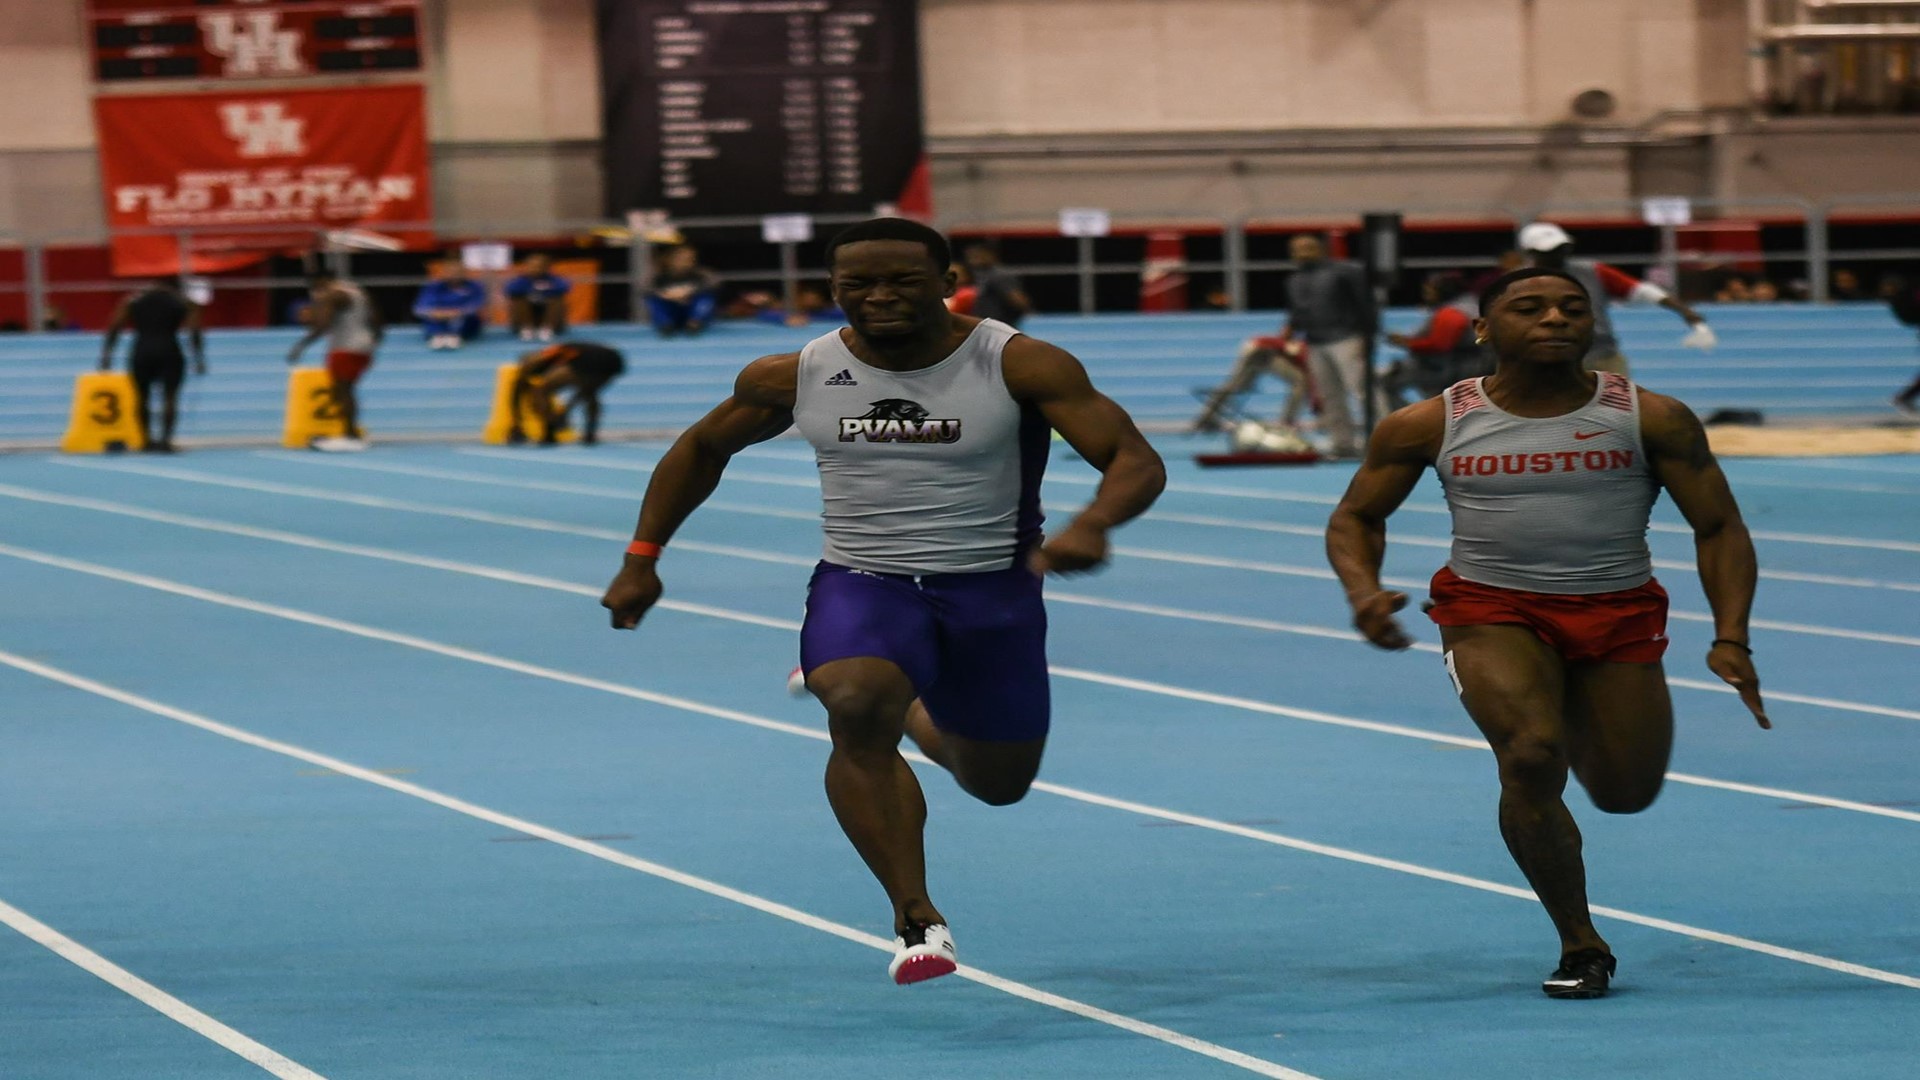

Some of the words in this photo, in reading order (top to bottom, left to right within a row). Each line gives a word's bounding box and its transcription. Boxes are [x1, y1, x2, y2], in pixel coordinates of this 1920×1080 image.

[116, 184, 210, 213] FLO
[90, 391, 121, 425] 3
[311, 387, 343, 420] 2
[839, 417, 962, 443] PVAMU
[1452, 450, 1633, 476] HOUSTON
